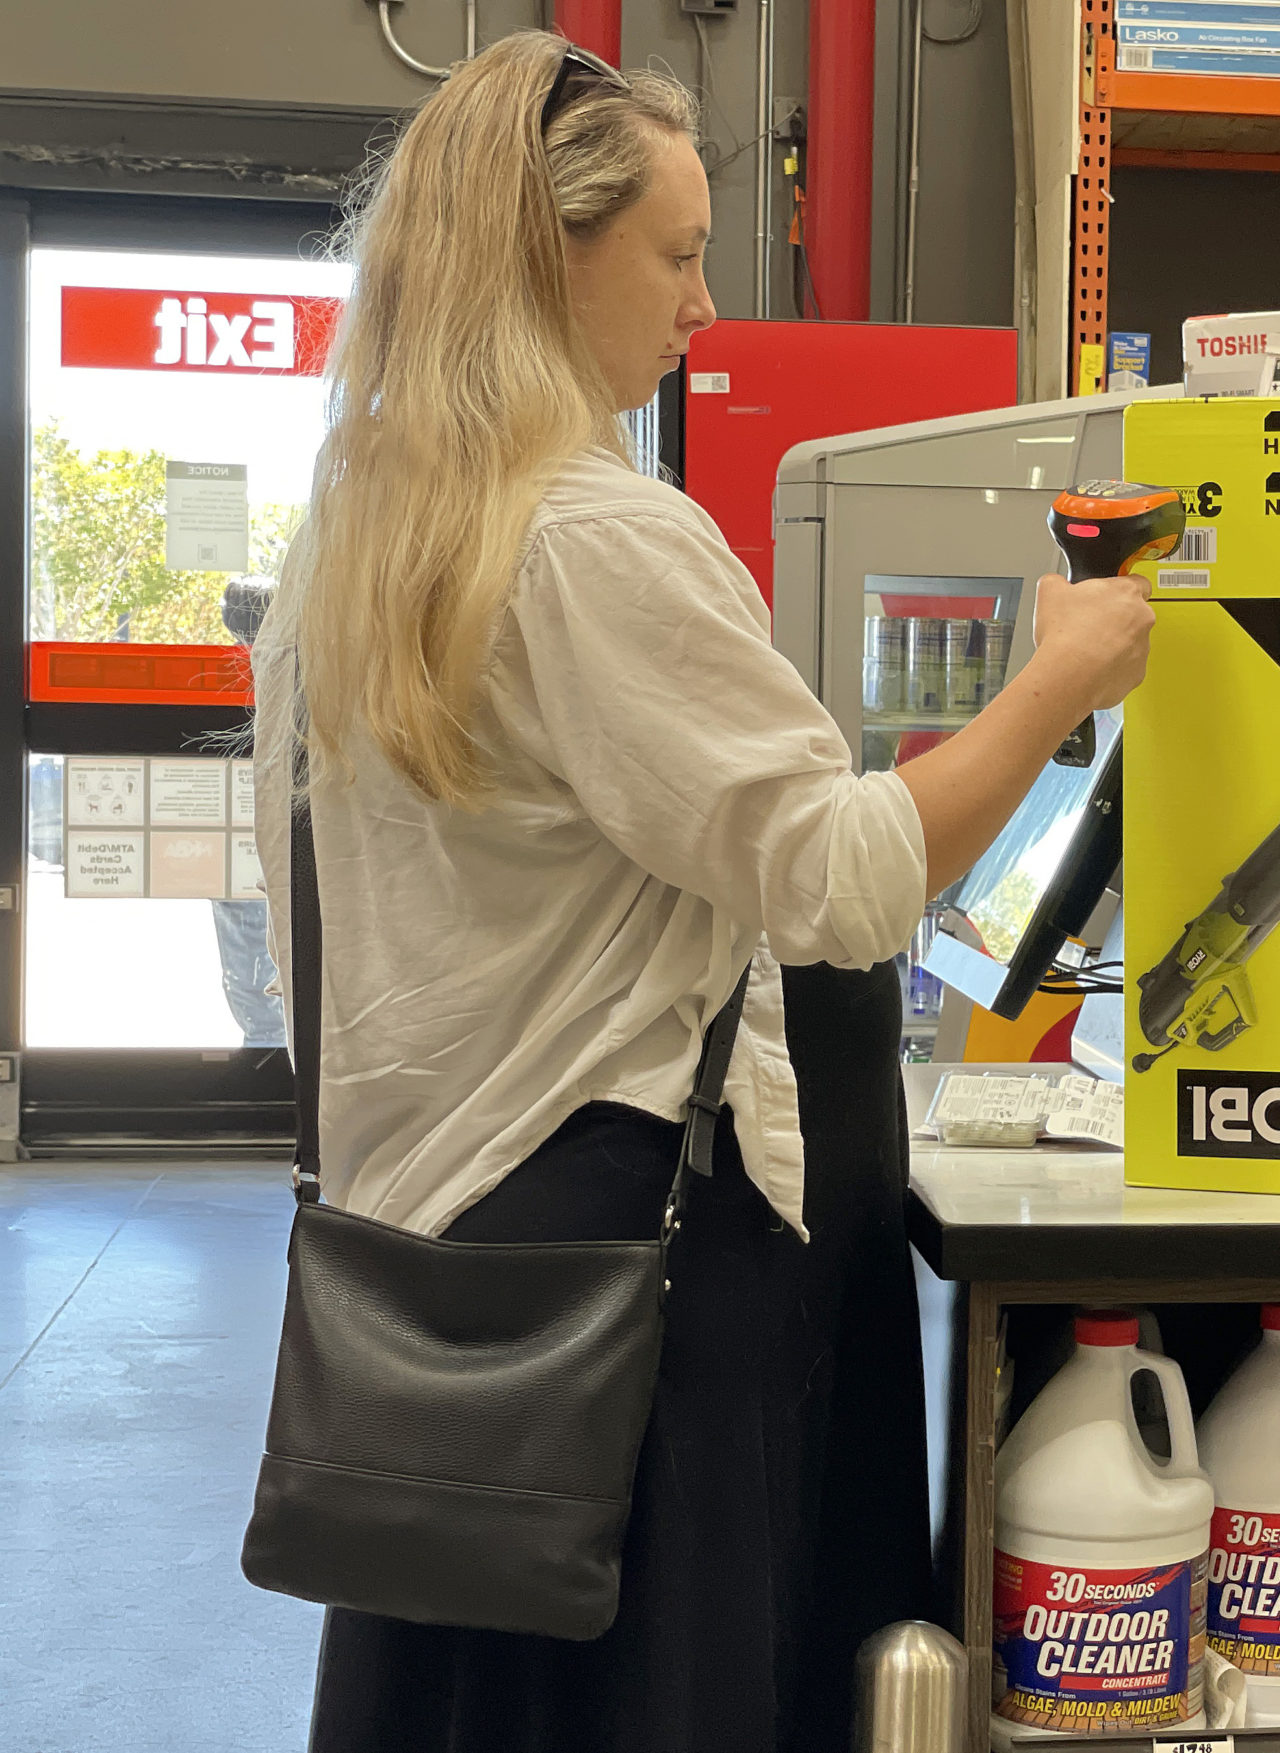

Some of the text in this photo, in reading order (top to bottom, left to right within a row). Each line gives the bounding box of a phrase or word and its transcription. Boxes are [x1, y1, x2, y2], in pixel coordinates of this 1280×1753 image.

[1125, 27, 1178, 41] Lasko
[1197, 482, 1223, 518] 3
[1226, 1515, 1263, 1546] 30
[1046, 1571, 1156, 1603] 30 SECONDS
[1023, 1605, 1169, 1642] OUTDOOR
[1037, 1640, 1174, 1677] CLEANER
[1101, 1675, 1168, 1689] CONCENTRATE
[1012, 1691, 1181, 1717] ALGAE, MOLD & MILDEW
